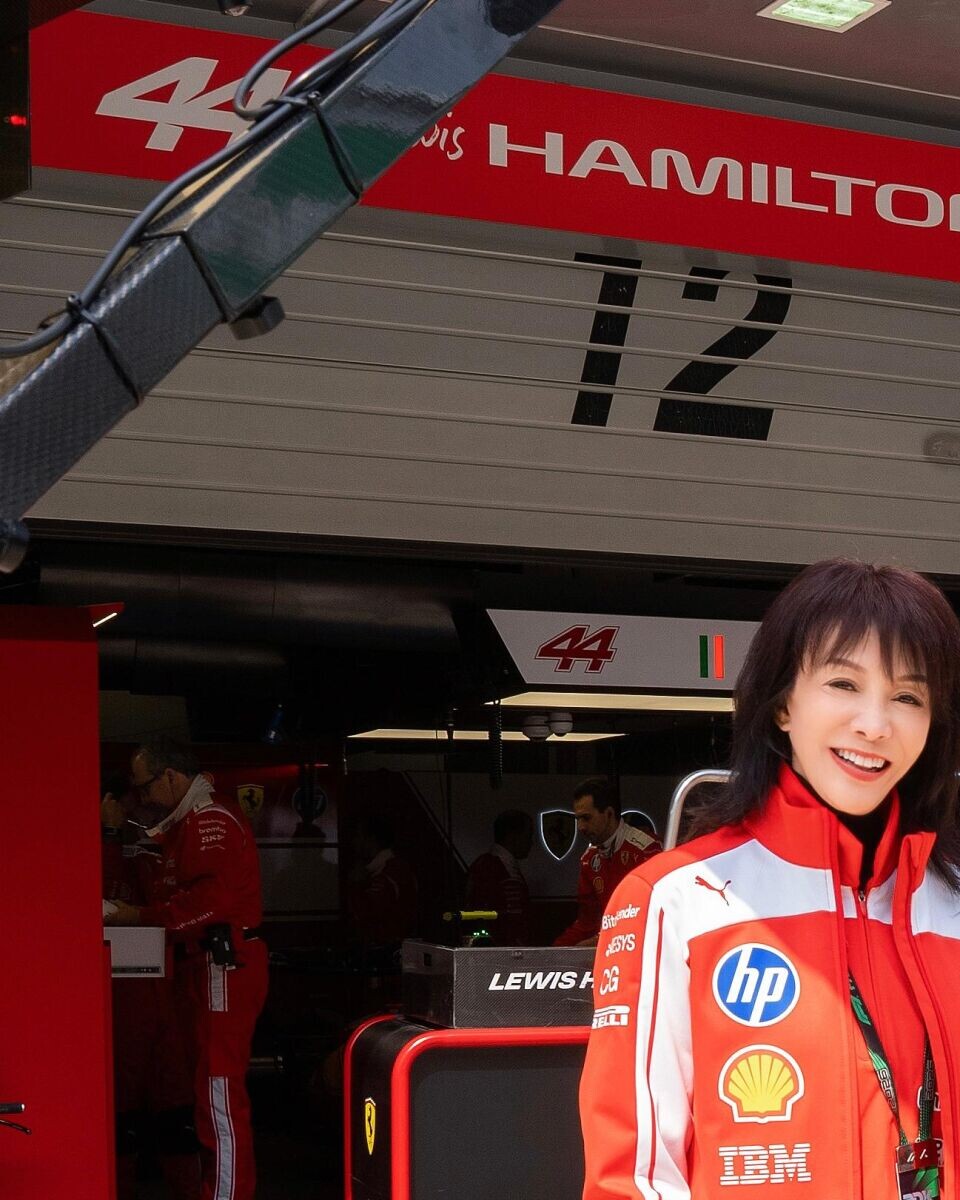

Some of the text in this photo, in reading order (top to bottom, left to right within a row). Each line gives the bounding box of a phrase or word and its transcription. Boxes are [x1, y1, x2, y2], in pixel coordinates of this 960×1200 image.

[95, 56, 291, 151] 44
[410, 111, 464, 160] wis
[571, 251, 793, 441] 12
[534, 624, 620, 674] 44
[488, 971, 578, 991] LEWIS
[726, 945, 789, 1025] hp
[718, 1143, 812, 1186] IBM
